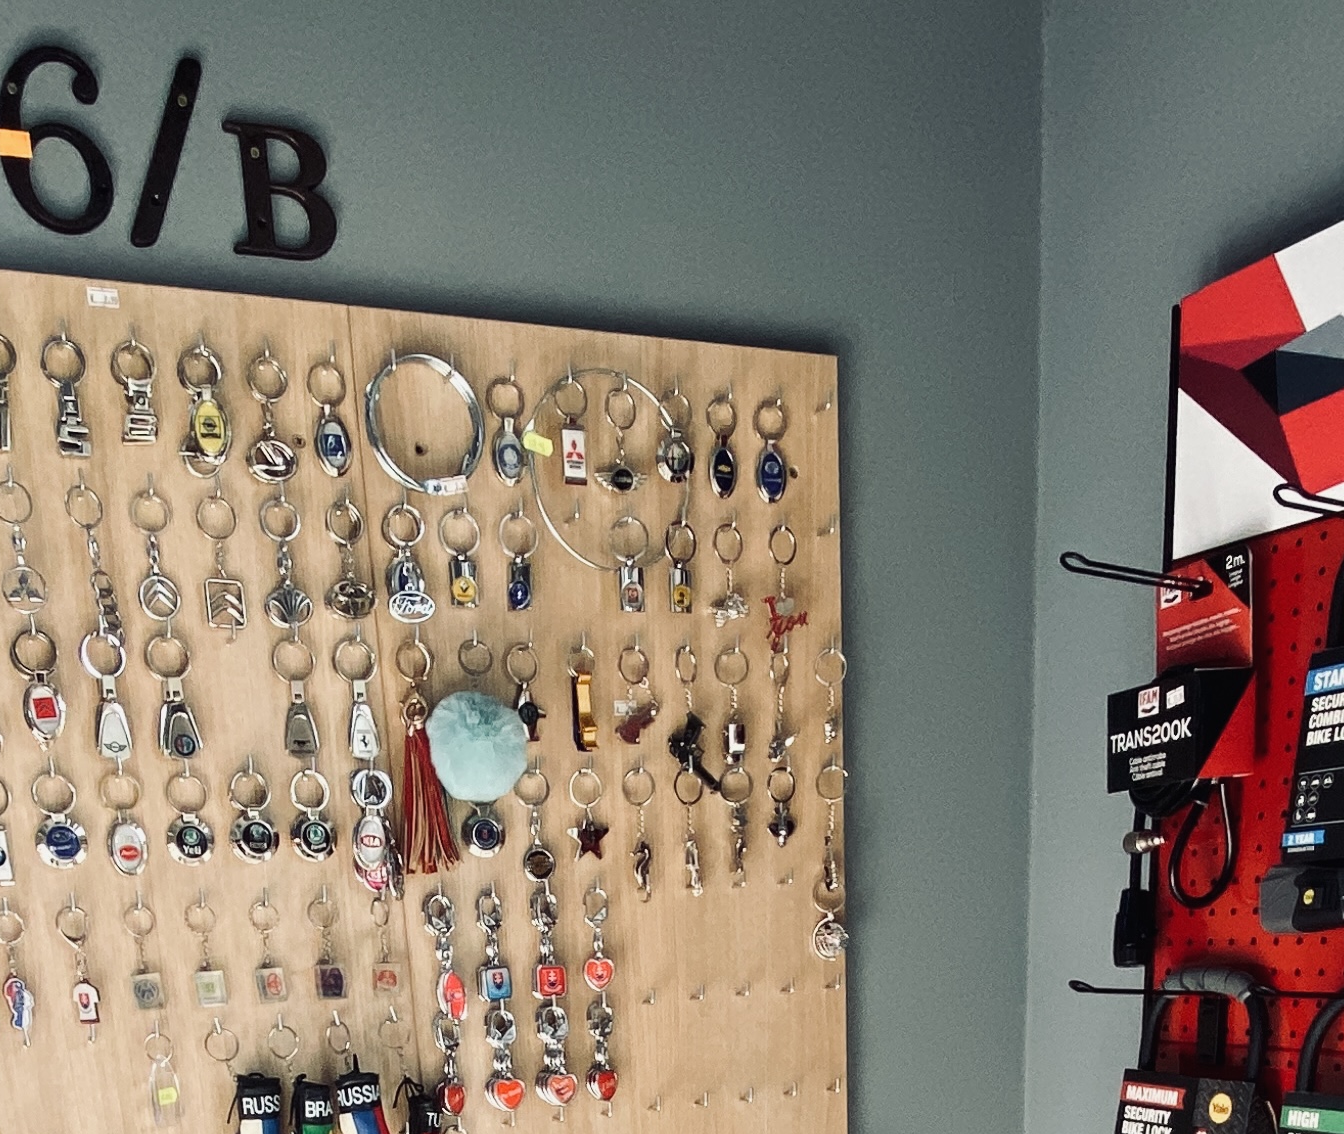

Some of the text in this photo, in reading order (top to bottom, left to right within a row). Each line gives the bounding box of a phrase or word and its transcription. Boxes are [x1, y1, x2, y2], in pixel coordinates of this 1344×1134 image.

[391, 593, 435, 619] Ford
[1110, 717, 1193, 754] TRANS200K
[1306, 728, 1332, 747] BIKE
[183, 844, 202, 855] Yeti
[1126, 1085, 1179, 1106] MAXIMUM
[1124, 1105, 1172, 1124] SECURITY
[1287, 1110, 1319, 1129] HIGH
